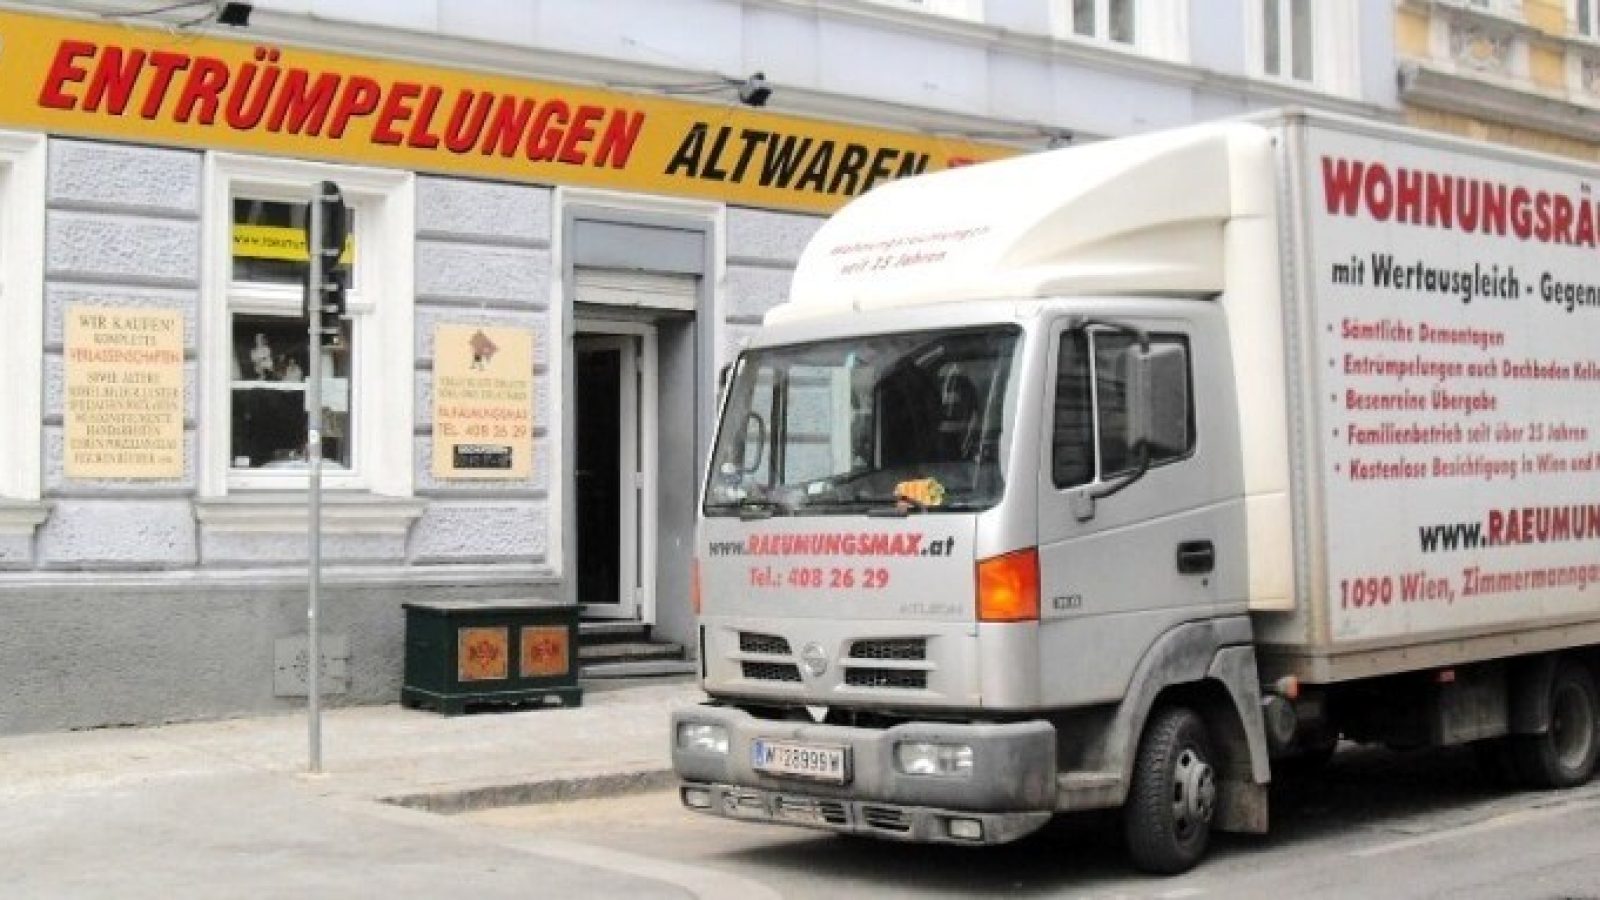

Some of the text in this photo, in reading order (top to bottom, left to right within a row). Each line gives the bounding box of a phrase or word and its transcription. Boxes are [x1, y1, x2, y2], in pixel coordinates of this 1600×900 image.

[39, 40, 646, 170] ENTRÜMPELUNGEN
[1321, 155, 1600, 248] WOHNUNGSRÄ
[1332, 254, 1365, 285] mit
[1372, 253, 1519, 304] Wertausgleich
[1541, 271, 1600, 313] Gegen
[1341, 319, 1504, 351] Sämtliche Demontagen
[1344, 354, 1462, 382] Entrümpelungen
[1468, 358, 1497, 378] auch
[1503, 359, 1569, 379] Dachboden
[1346, 387, 1497, 416] Besenreine Übergabe
[1348, 422, 1462, 446] Familienbetrieb
[1467, 422, 1491, 443] seit
[1495, 422, 1523, 443] über
[1548, 422, 1588, 442] Jahren
[1350, 456, 1427, 481] Kostenlose
[1432, 455, 1517, 481] Besichtigung
[1521, 451, 1533, 472] in
[1537, 453, 1567, 473] Wien
[1571, 451, 1592, 471] und
[708, 532, 956, 557] www.RAEUMUNGSMAX.at
[750, 566, 889, 588] Tel.: 408 26 29
[1340, 575, 1393, 611] 1090
[1400, 570, 1455, 607] Wien,
